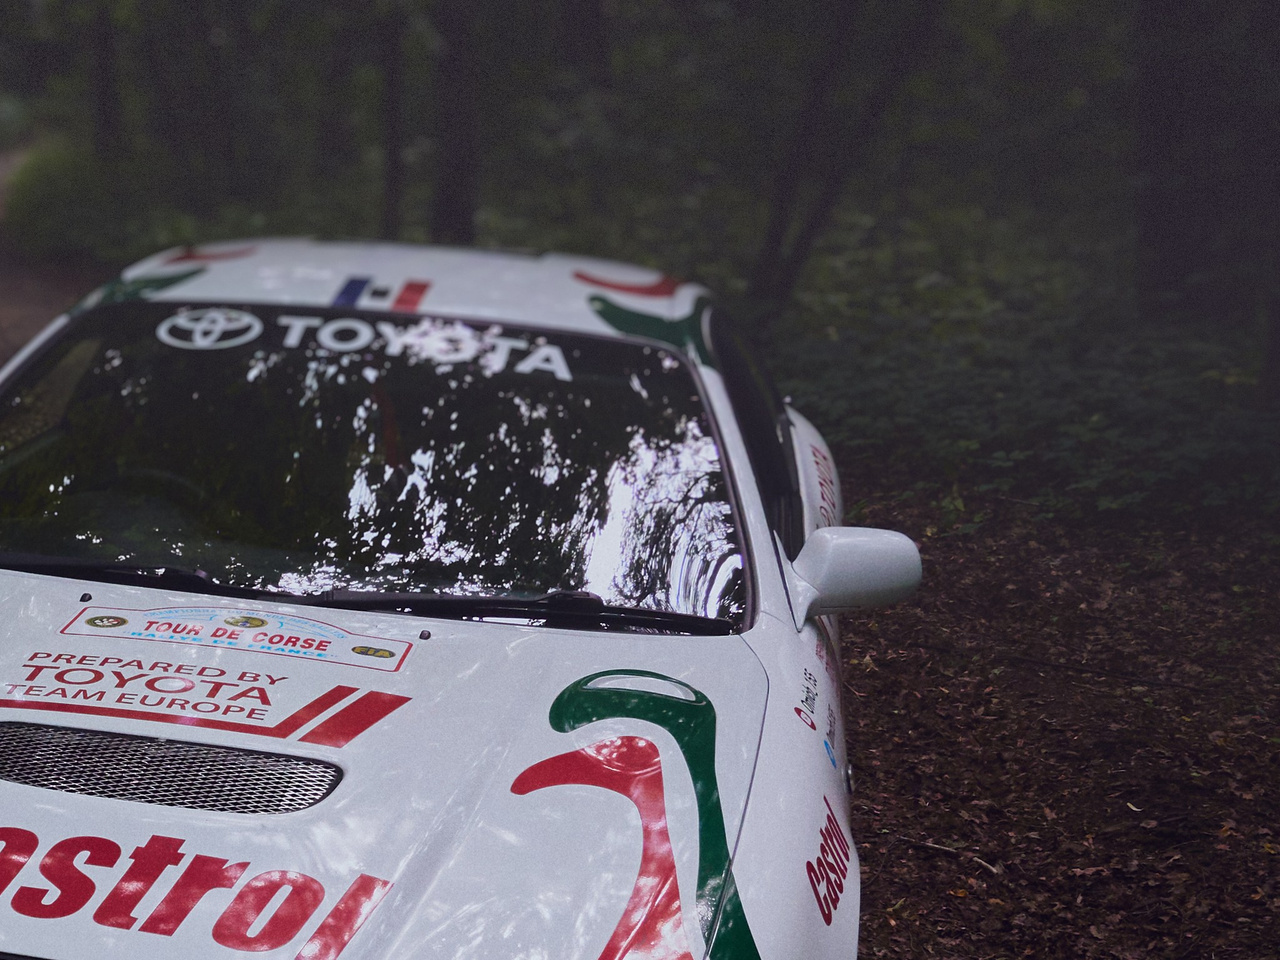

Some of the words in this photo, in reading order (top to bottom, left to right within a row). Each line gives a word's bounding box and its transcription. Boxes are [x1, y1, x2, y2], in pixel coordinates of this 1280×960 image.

[277, 315, 572, 381] TOYOTA
[144, 620, 204, 635] TOUR
[211, 627, 244, 640] DE
[252, 632, 332, 651] CORSE
[22, 664, 272, 707] TOYOTA
[28, 652, 227, 678] PREPARED
[237, 671, 289, 685] BY
[5, 684, 106, 701] TEAM
[115, 693, 269, 720] EUROPE
[806, 794, 850, 926] Castrol
